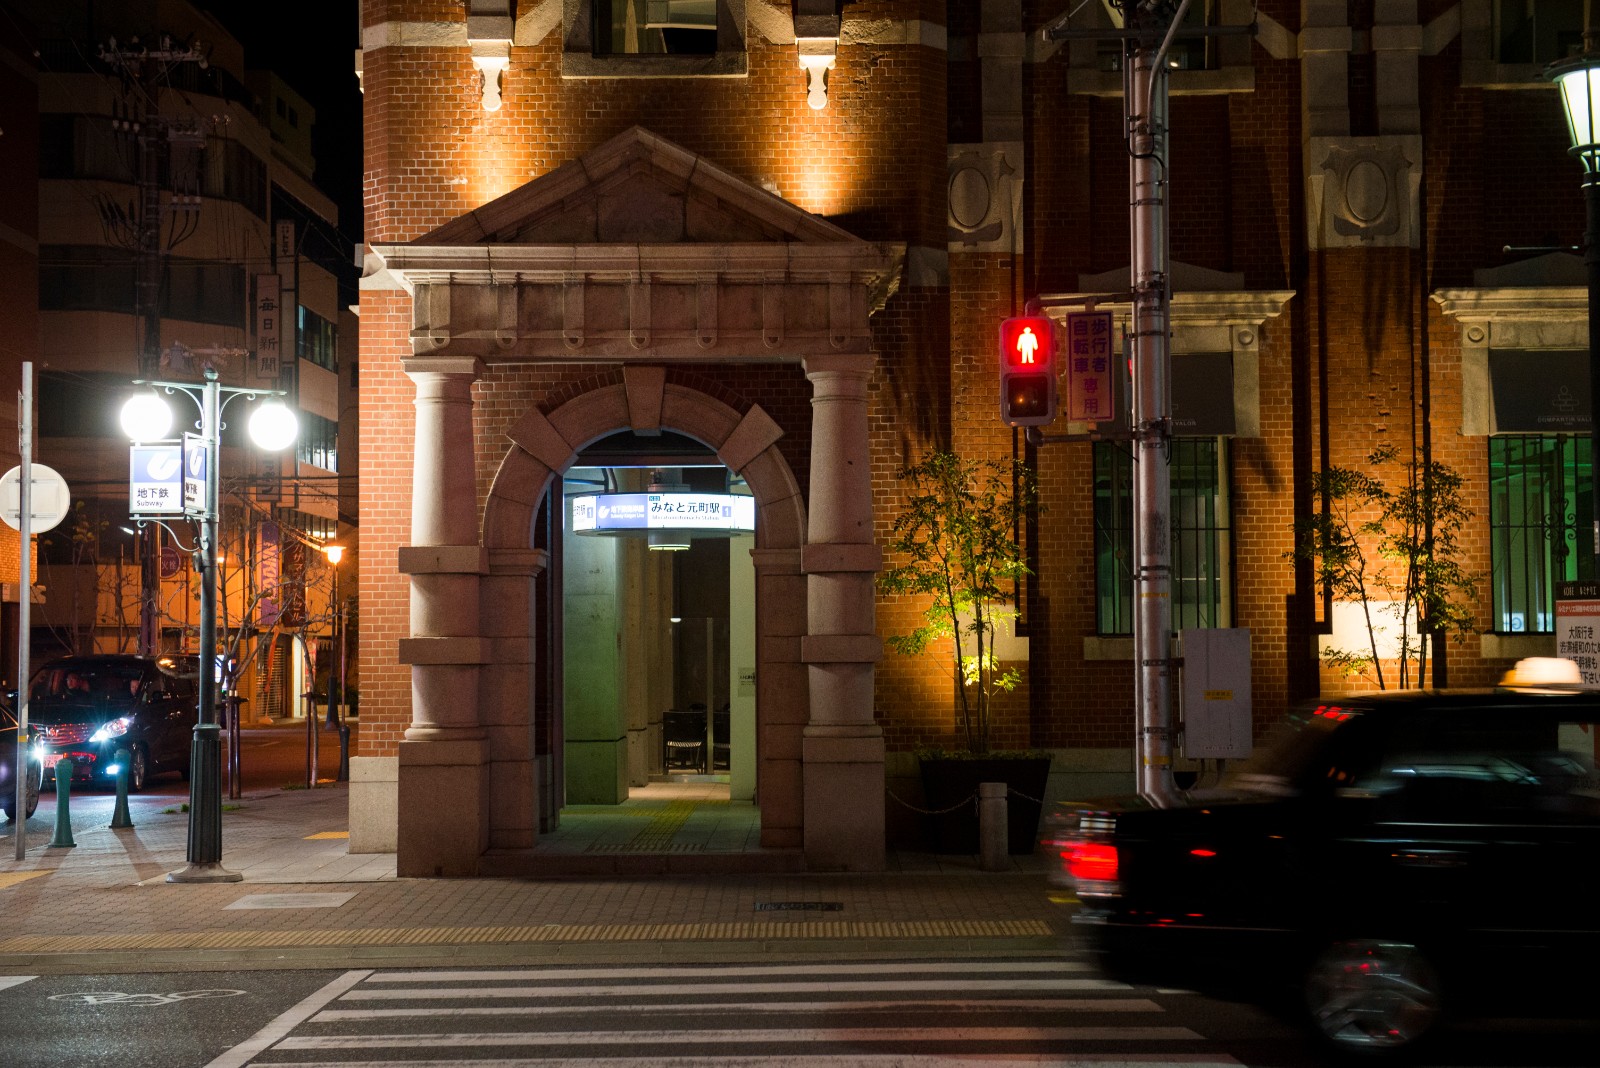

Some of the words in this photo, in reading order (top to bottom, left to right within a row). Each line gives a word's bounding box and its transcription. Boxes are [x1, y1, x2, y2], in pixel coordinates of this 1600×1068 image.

[258, 298, 279, 373] 毎日新聞
[1073, 321, 1088, 373] 自転車
[1091, 320, 1107, 372] 歩行者
[1083, 377, 1099, 414] 専用
[137, 487, 169, 499] 地下鉄
[651, 502, 720, 514] みなと元町駅
[1579, 586, 1597, 596] ルミナリエ
[1569, 626, 1593, 639] 大阪行き
